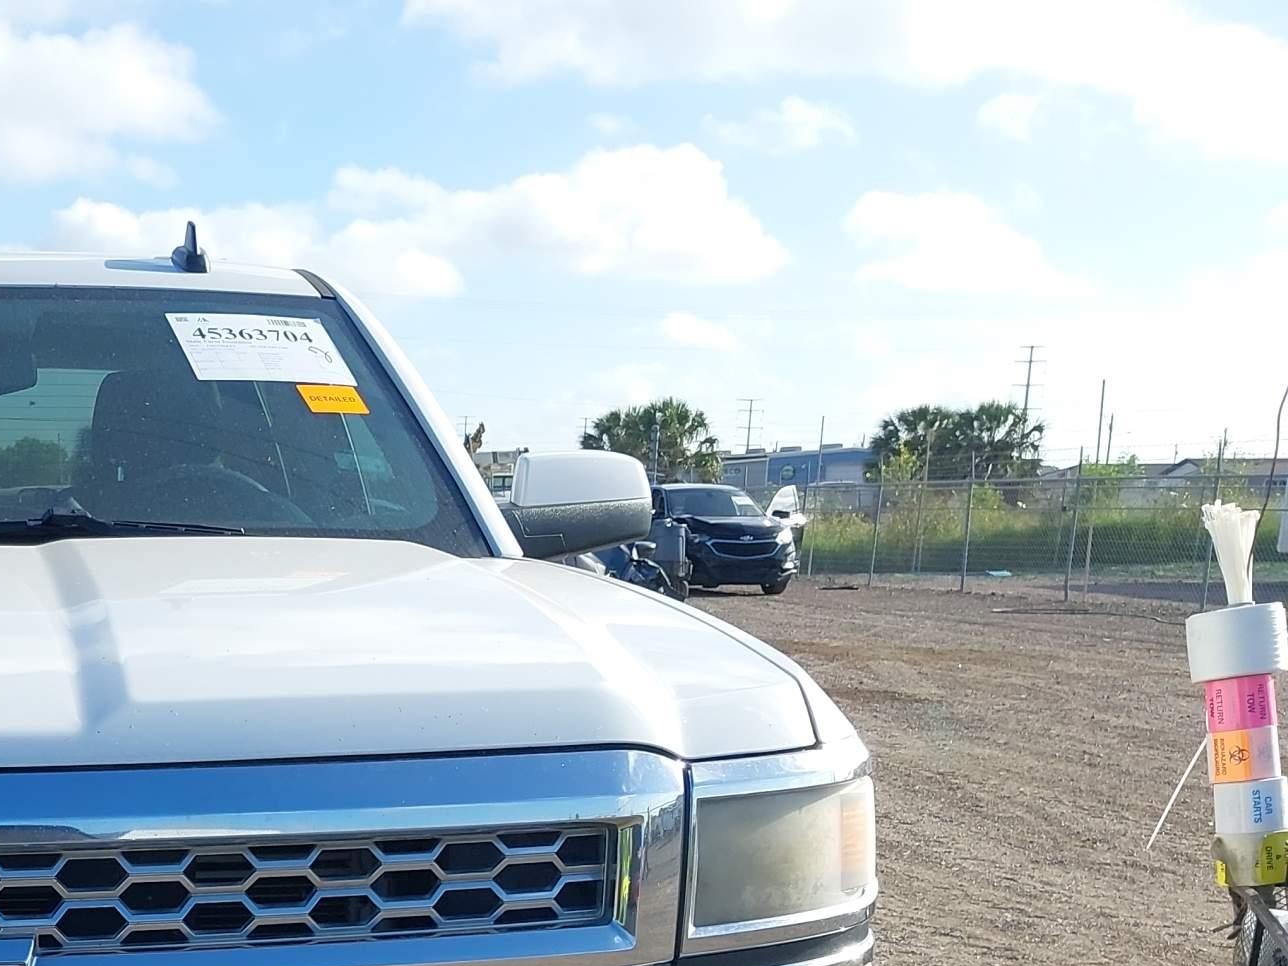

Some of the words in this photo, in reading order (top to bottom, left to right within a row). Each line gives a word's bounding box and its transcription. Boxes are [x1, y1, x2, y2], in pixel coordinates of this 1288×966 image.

[192, 327, 313, 343] 45363704
[309, 394, 357, 403] DETAILED
[1216, 688, 1225, 725] RETURN
[1246, 693, 1256, 713] TOW
[1257, 684, 1266, 720] RETURN
[1252, 789, 1263, 824] STARTS
[1264, 796, 1273, 815] CAR
[1265, 846, 1274, 871] DRIVE
